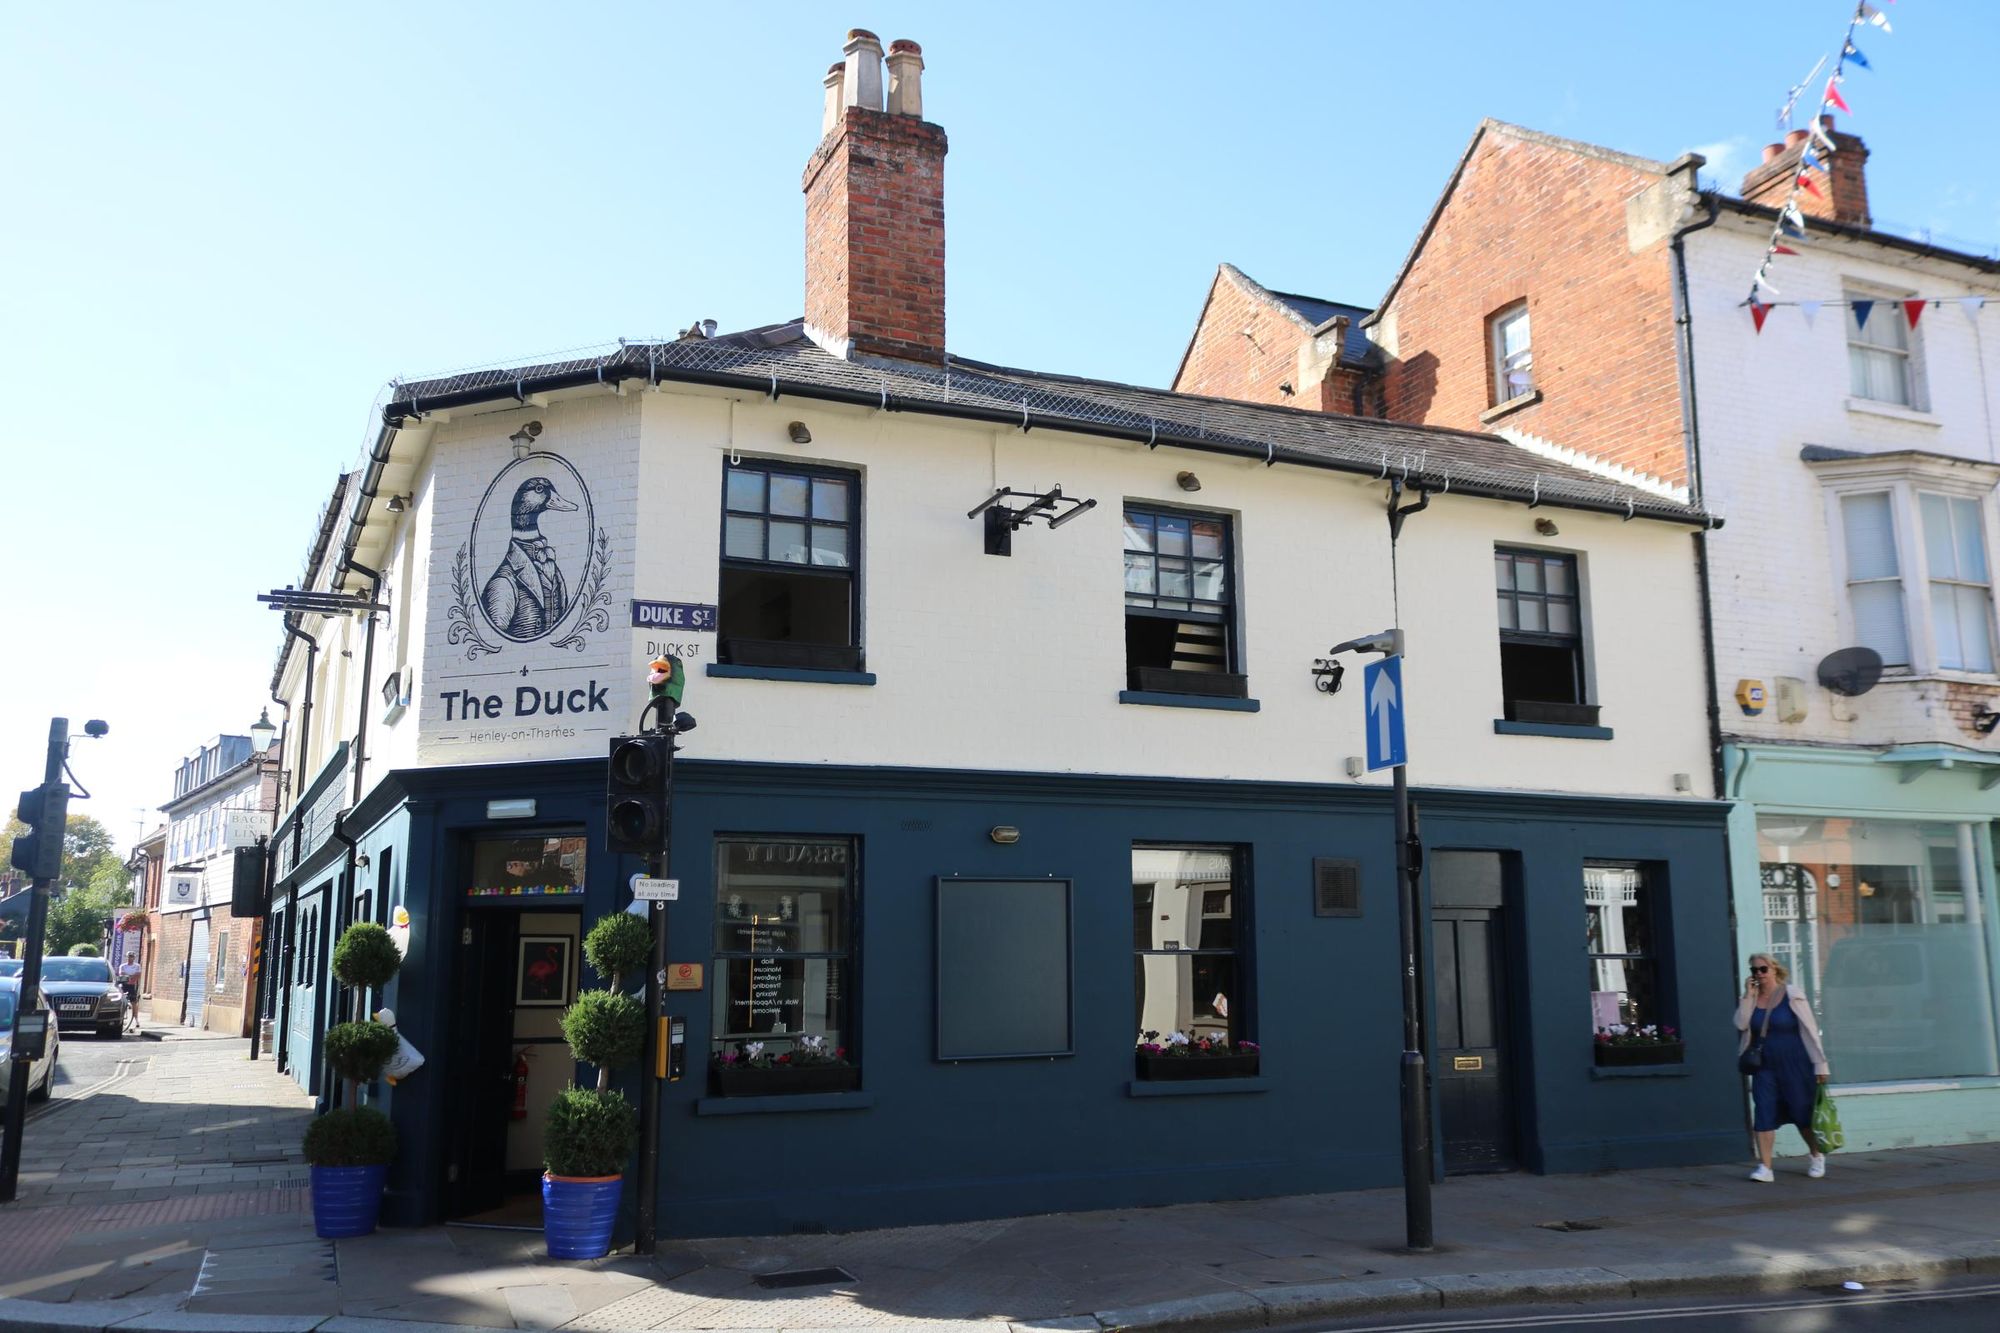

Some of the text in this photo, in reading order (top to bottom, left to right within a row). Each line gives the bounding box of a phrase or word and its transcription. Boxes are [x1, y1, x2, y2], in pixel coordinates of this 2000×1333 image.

[639, 605, 684, 625] DUKE
[647, 641, 684, 657] DUCK
[440, 680, 610, 721] The Duck
[470, 726, 576, 743] Henley-on-Thames
[232, 815, 268, 825] BACK
[650, 881, 676, 889] loading
